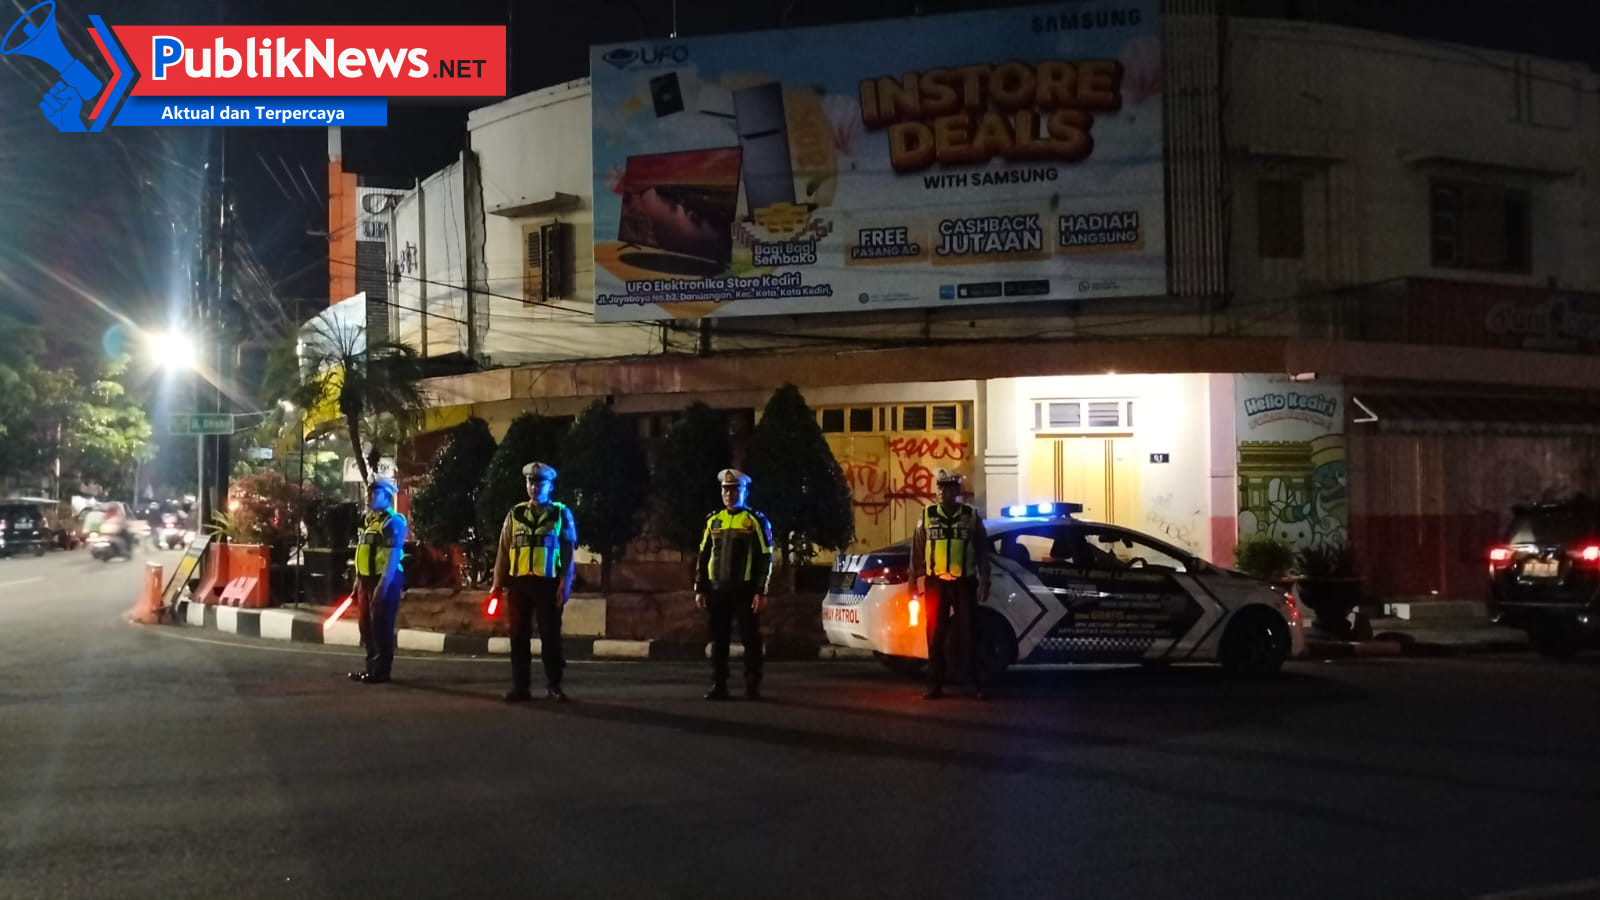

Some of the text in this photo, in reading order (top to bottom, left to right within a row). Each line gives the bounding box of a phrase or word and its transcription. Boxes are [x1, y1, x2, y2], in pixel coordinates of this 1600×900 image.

[1032, 8, 1142, 33] SAMSUNG
[640, 45, 689, 65] UFO
[860, 59, 1124, 129] INSTORE
[888, 107, 1094, 171] DEALS
[924, 168, 1058, 189] WITH SAMSUNG
[939, 214, 1041, 235] CASHBACK
[1059, 211, 1138, 233] HADIAH
[860, 227, 906, 247] FREE
[936, 230, 1043, 256] JUTAAN
[1060, 230, 1138, 246] LANGSUNG
[753, 240, 816, 256] Bagi Bagi
[852, 244, 919, 258] PASANG AC
[754, 253, 816, 266] Sembako
[627, 273, 800, 292] UFO Elektronika Store Kediri
[1244, 394, 1285, 416] Hello
